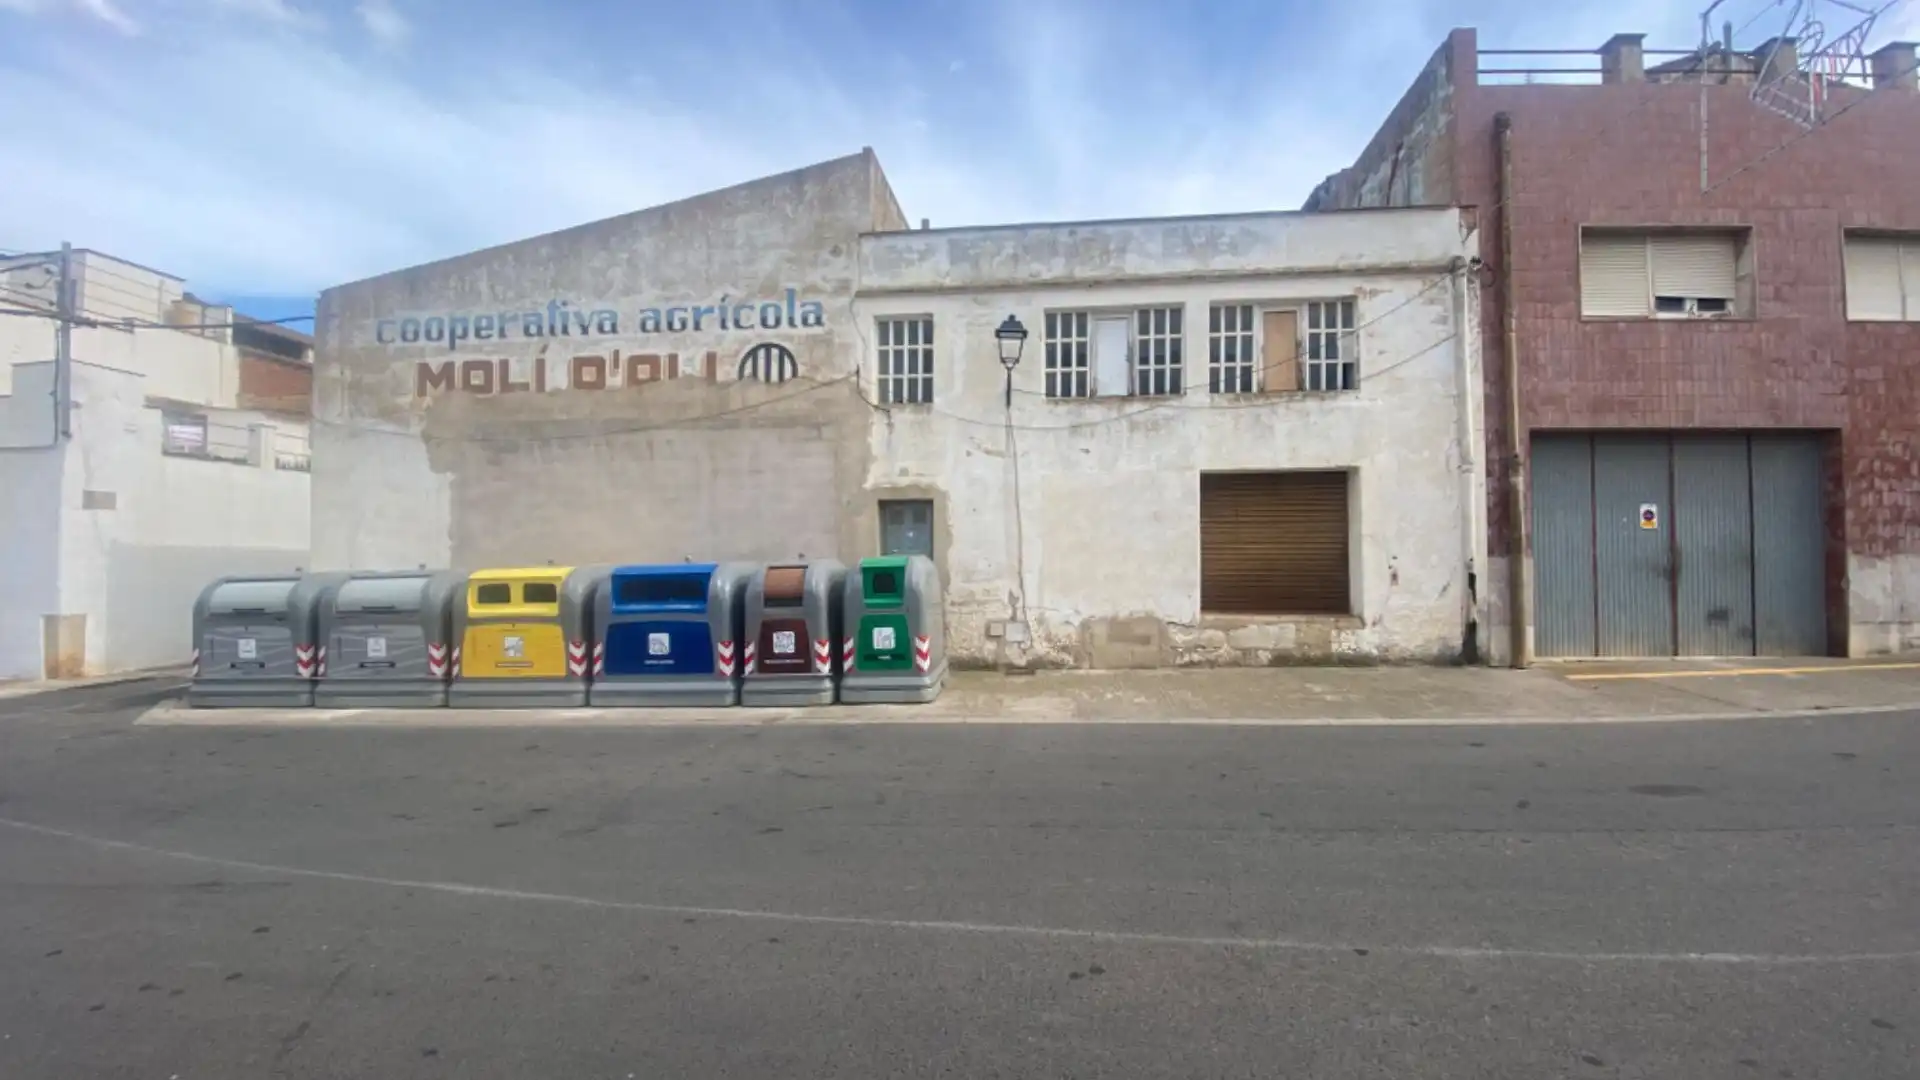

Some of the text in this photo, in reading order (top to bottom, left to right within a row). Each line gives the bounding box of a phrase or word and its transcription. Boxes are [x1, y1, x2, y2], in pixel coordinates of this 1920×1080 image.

[376, 288, 824, 350] cooperativa agrícola
[416, 344, 549, 398] MOLÍ
